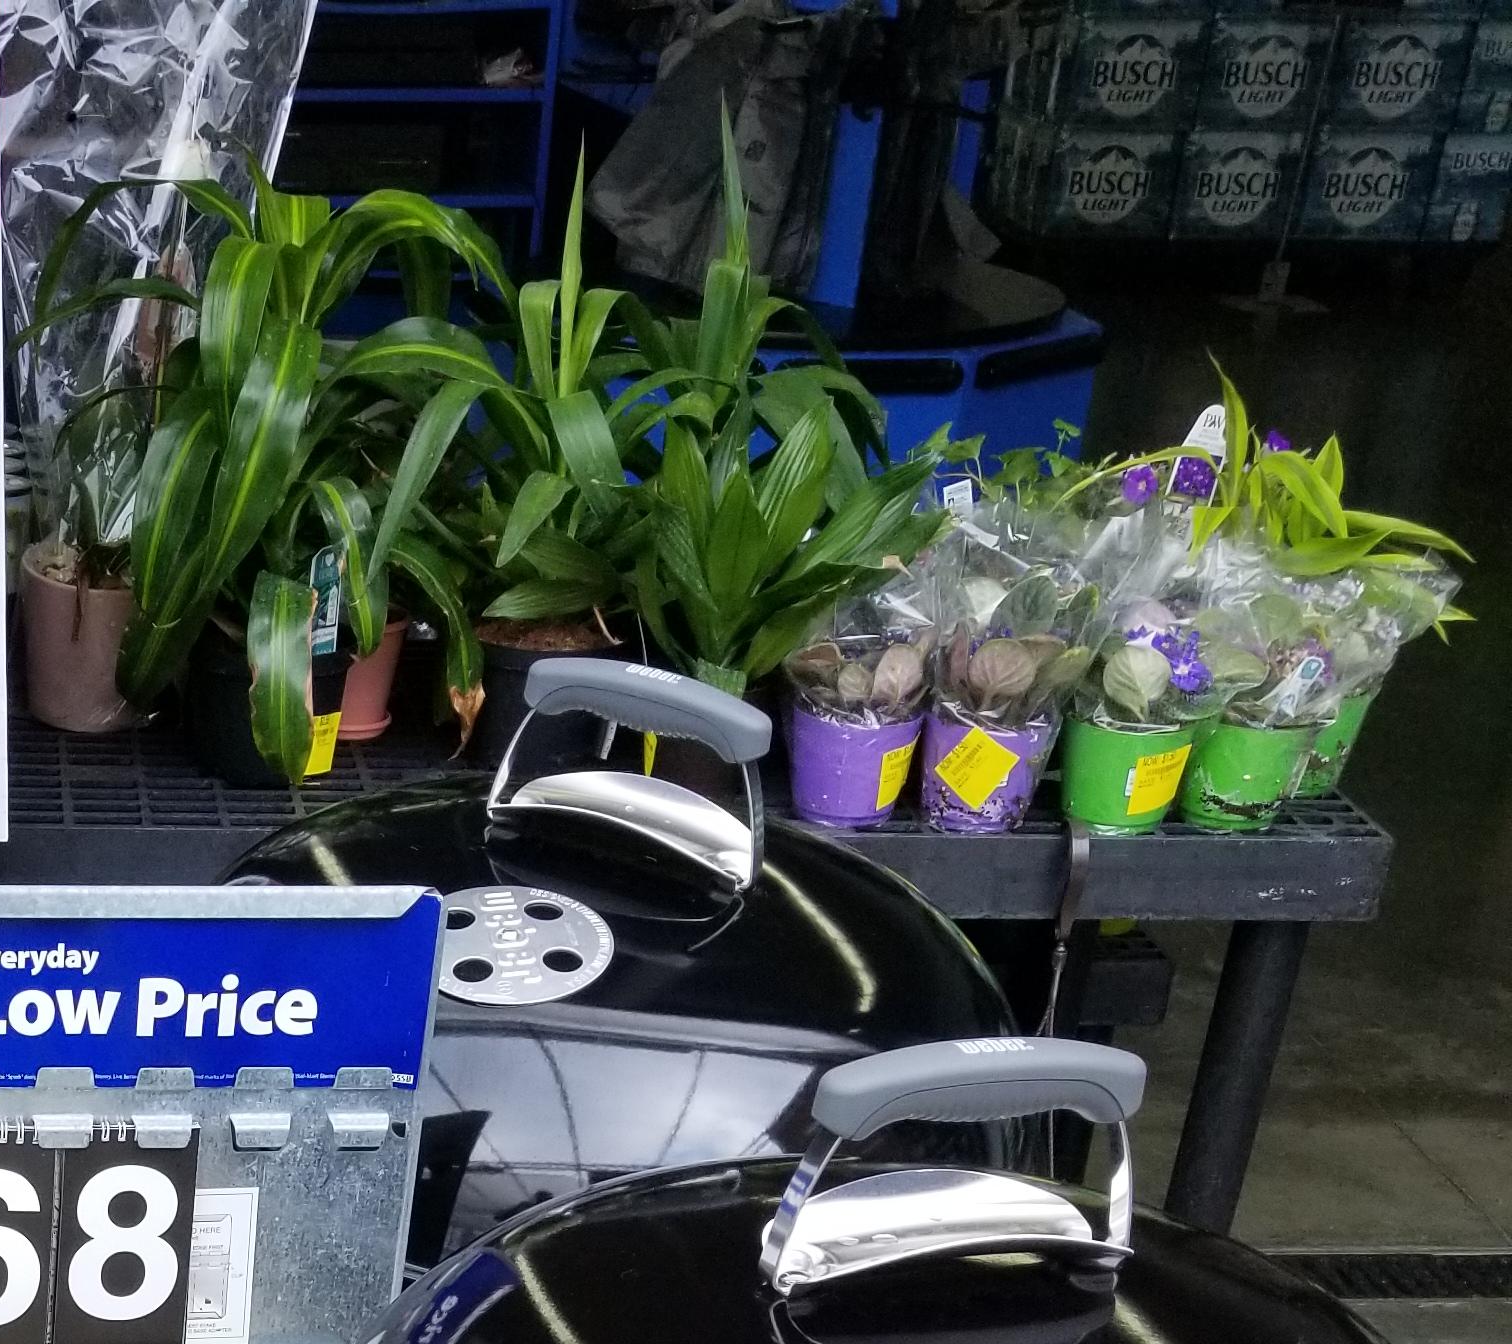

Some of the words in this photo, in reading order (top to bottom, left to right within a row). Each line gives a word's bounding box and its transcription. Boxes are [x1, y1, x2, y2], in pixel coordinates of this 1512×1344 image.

[1093, 60, 1176, 88] BUSCH
[1223, 60, 1308, 89] BUSCH
[1353, 60, 1439, 89] BUSCH
[1107, 89, 1154, 103] LIGHT
[1238, 89, 1285, 104] LIGHT
[1368, 90, 1416, 104] LIGHT
[1069, 171, 1151, 197] BUSCH
[1197, 171, 1279, 199] BUSCH
[1324, 172, 1407, 200] BUSCH
[1082, 198, 1129, 212] LIGHT
[1212, 199, 1259, 213] LIGHT
[1338, 199, 1386, 214] LIGHT
[136, 974, 318, 1038] Price
